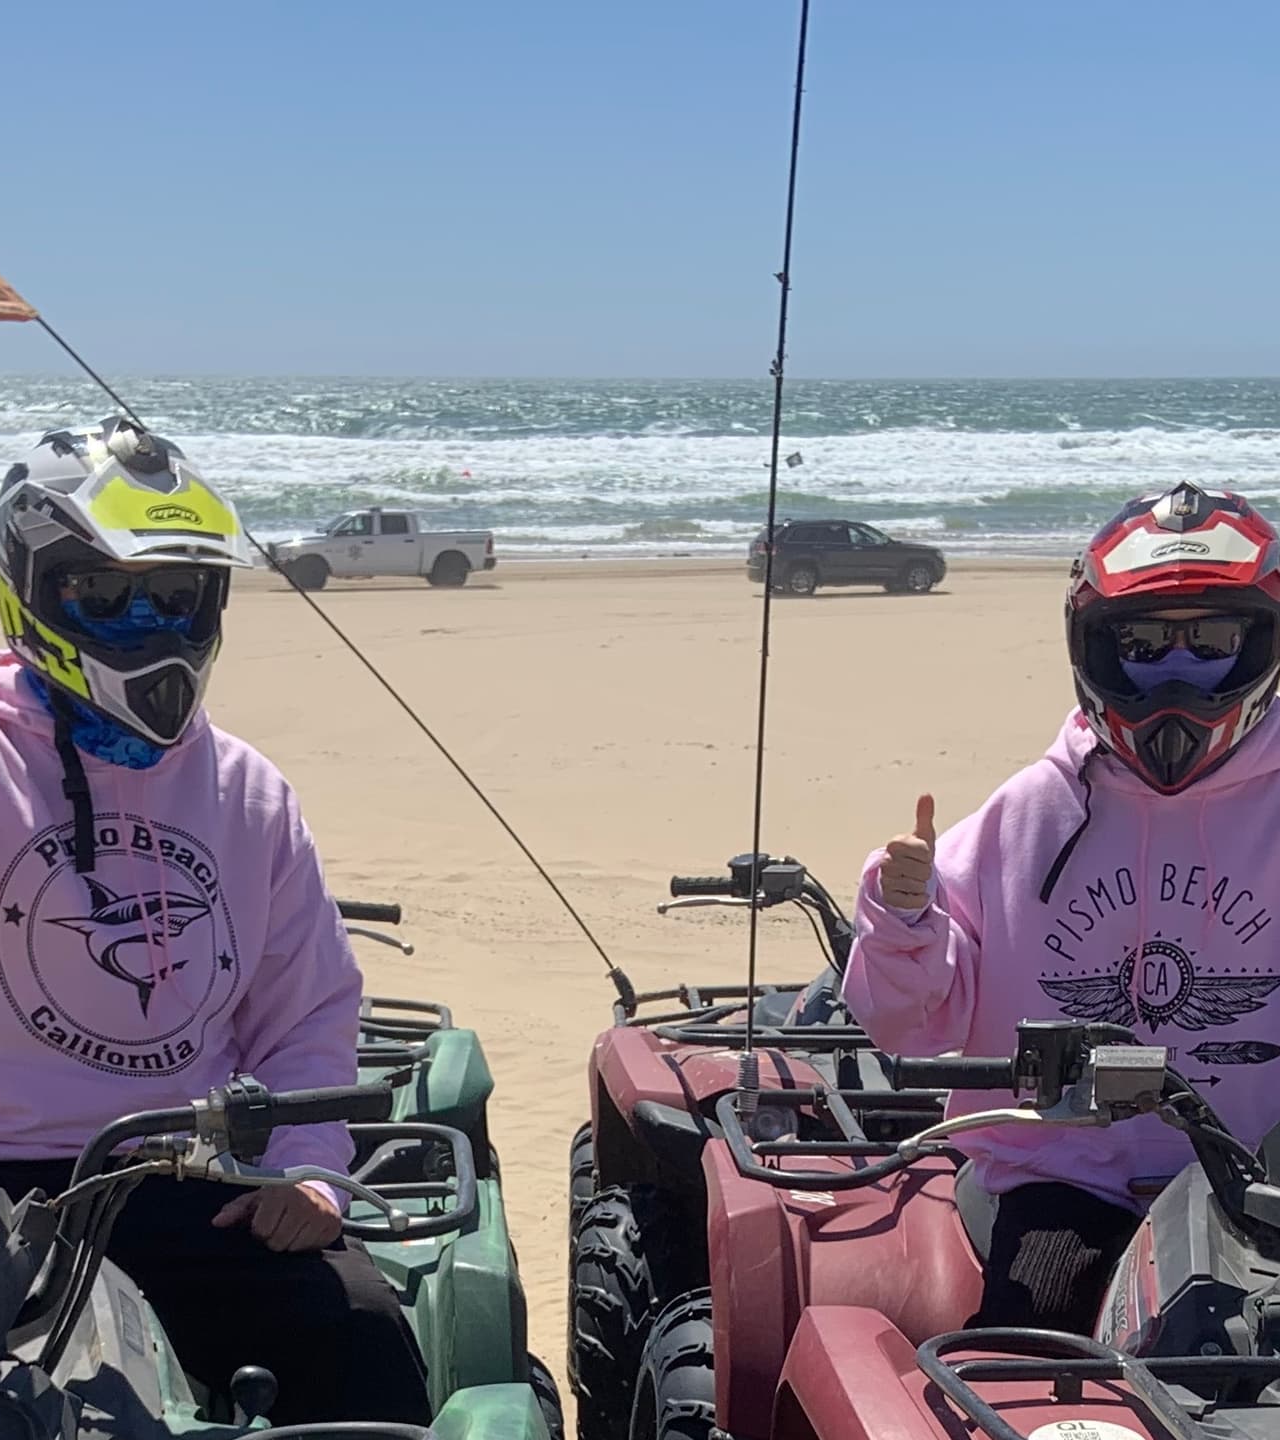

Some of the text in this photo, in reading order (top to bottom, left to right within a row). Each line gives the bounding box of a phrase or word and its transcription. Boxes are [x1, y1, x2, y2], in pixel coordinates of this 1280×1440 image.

[1044, 863, 1272, 962] PISMO BEACH
[1143, 961, 1169, 997] CA
[30, 1004, 196, 1070] California
[1056, 1421, 1097, 1431] QL
